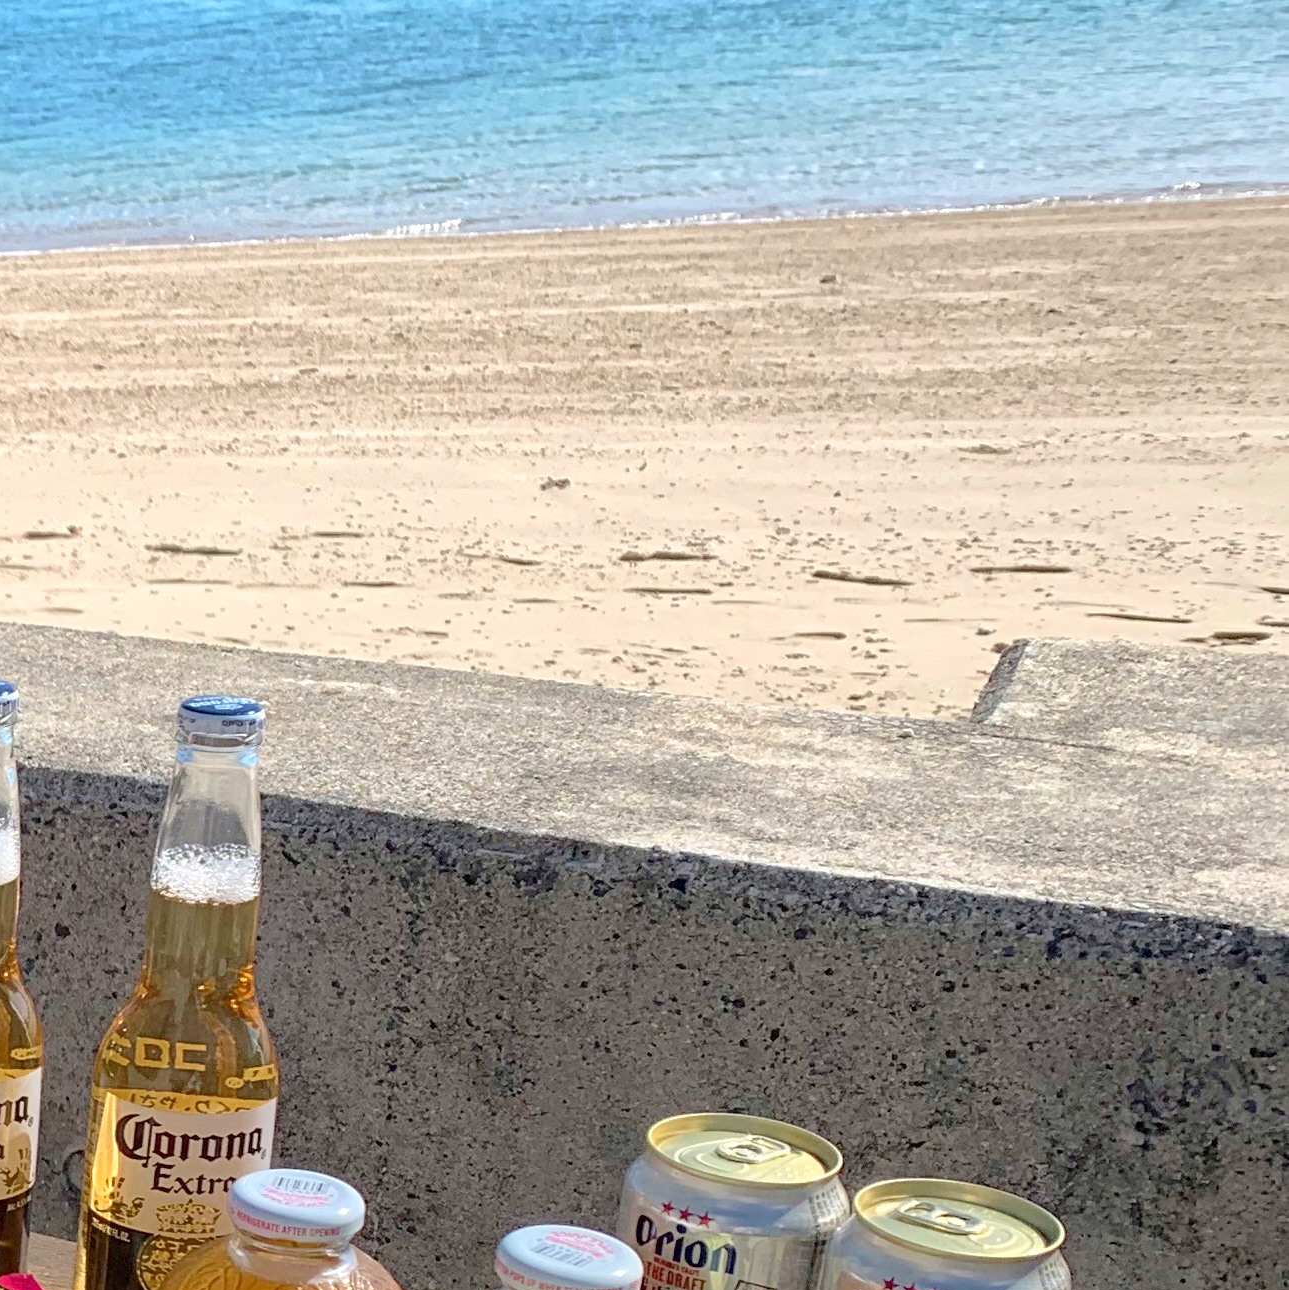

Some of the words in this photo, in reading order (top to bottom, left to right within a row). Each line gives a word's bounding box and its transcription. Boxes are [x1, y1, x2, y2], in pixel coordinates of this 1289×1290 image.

[116, 1113, 263, 1168] Corona
[236, 1209, 281, 1233] REFRIGERATE
[282, 1226, 308, 1237] AFTER
[310, 1227, 341, 1238] OPENING
[636, 1214, 737, 1275] Orion
[645, 1262, 668, 1283] THE
